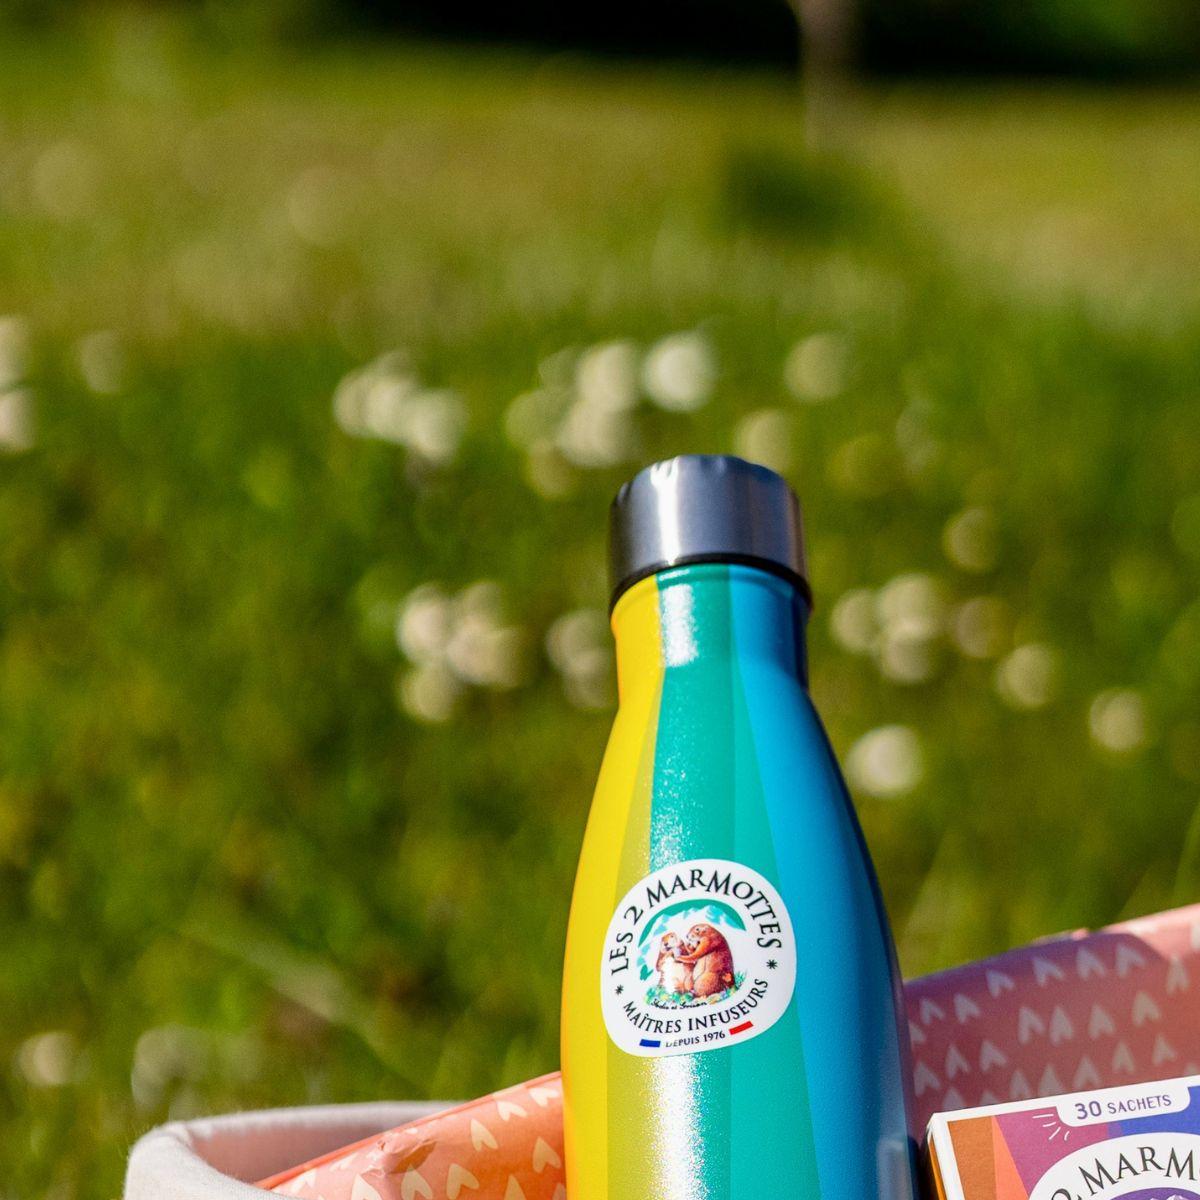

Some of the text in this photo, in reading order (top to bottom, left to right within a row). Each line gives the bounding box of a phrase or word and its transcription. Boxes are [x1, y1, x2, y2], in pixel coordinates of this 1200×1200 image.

[609, 868, 782, 977] LES 2 MARMOTTES
[623, 978, 769, 1034] MAÎTRES INFUSEURS
[703, 1030, 726, 1043] 1976
[1074, 1094, 1172, 1120] 30 SACHETS
